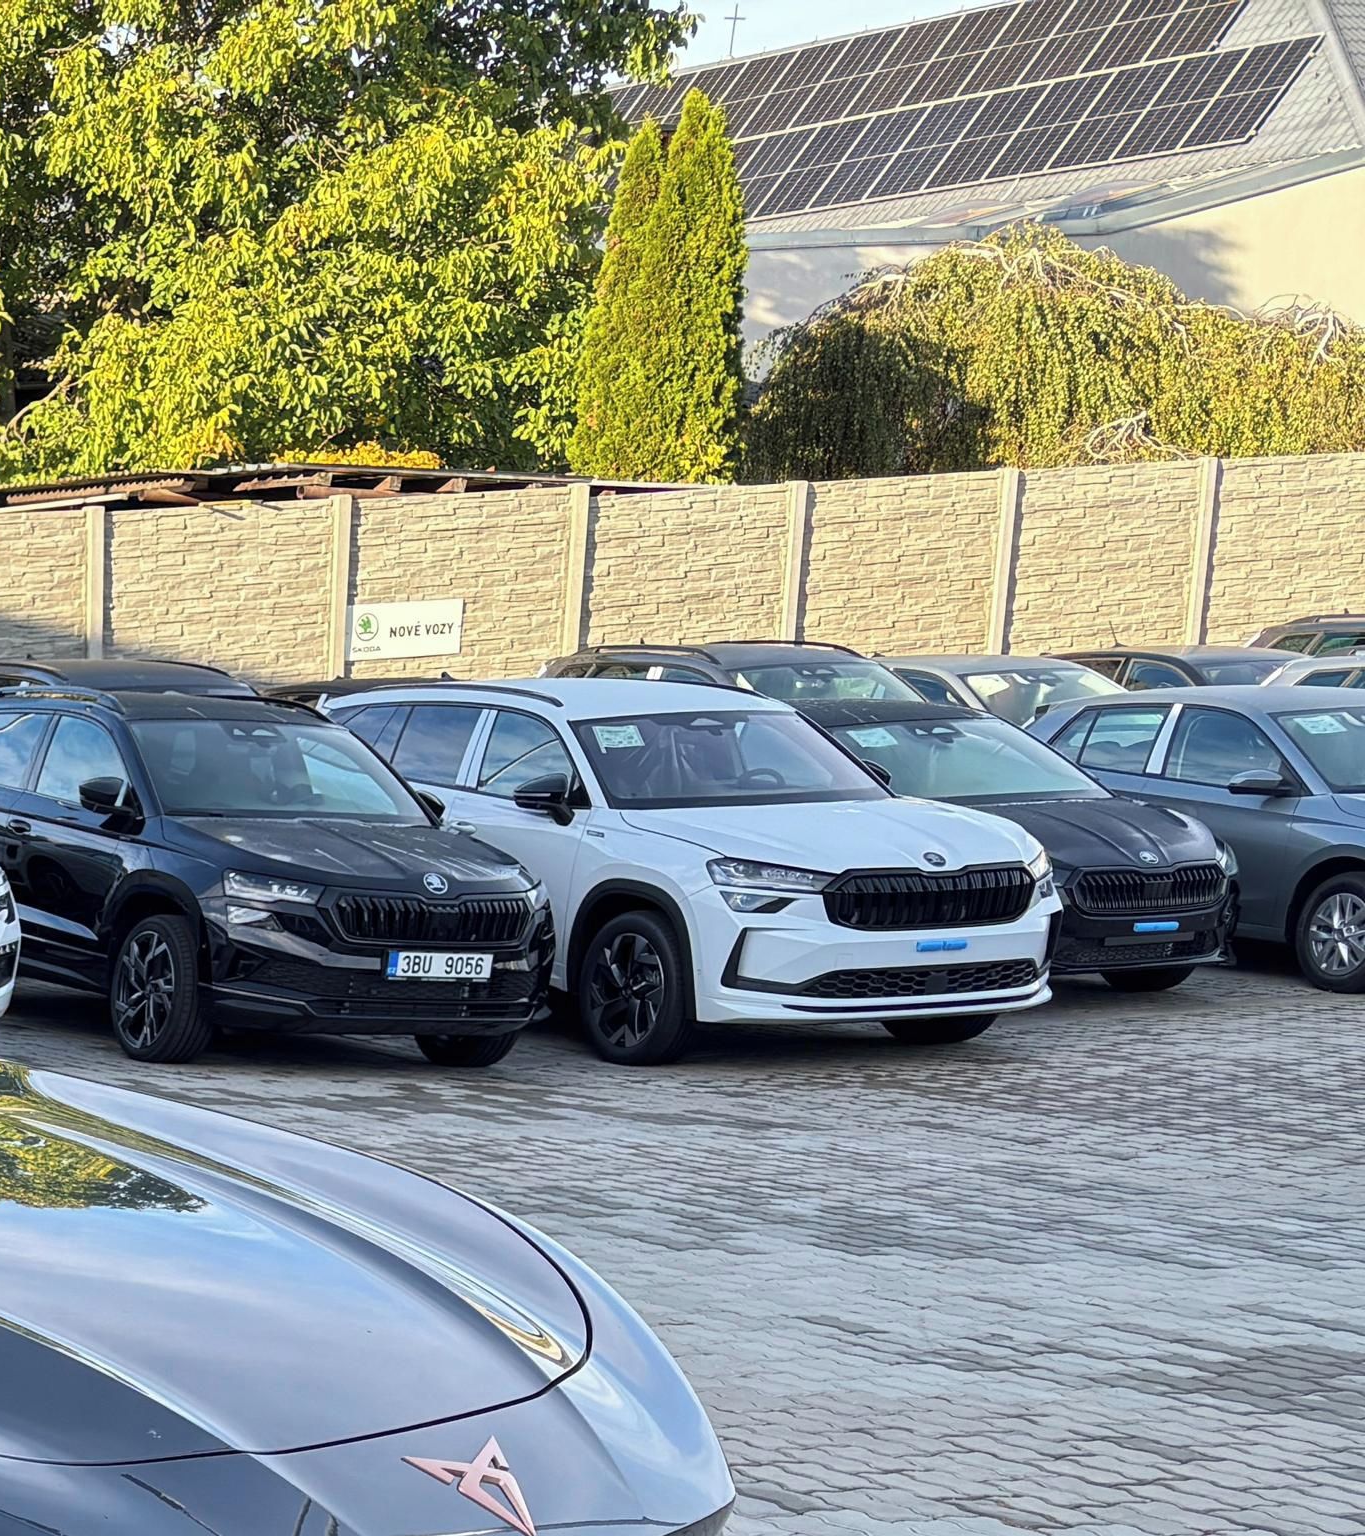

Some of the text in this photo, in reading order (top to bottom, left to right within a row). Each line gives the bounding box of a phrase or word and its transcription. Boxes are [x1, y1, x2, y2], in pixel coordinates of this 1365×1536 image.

[389, 621, 454, 638] NOVÉ VOZY
[401, 955, 484, 975] 3BU 9056
